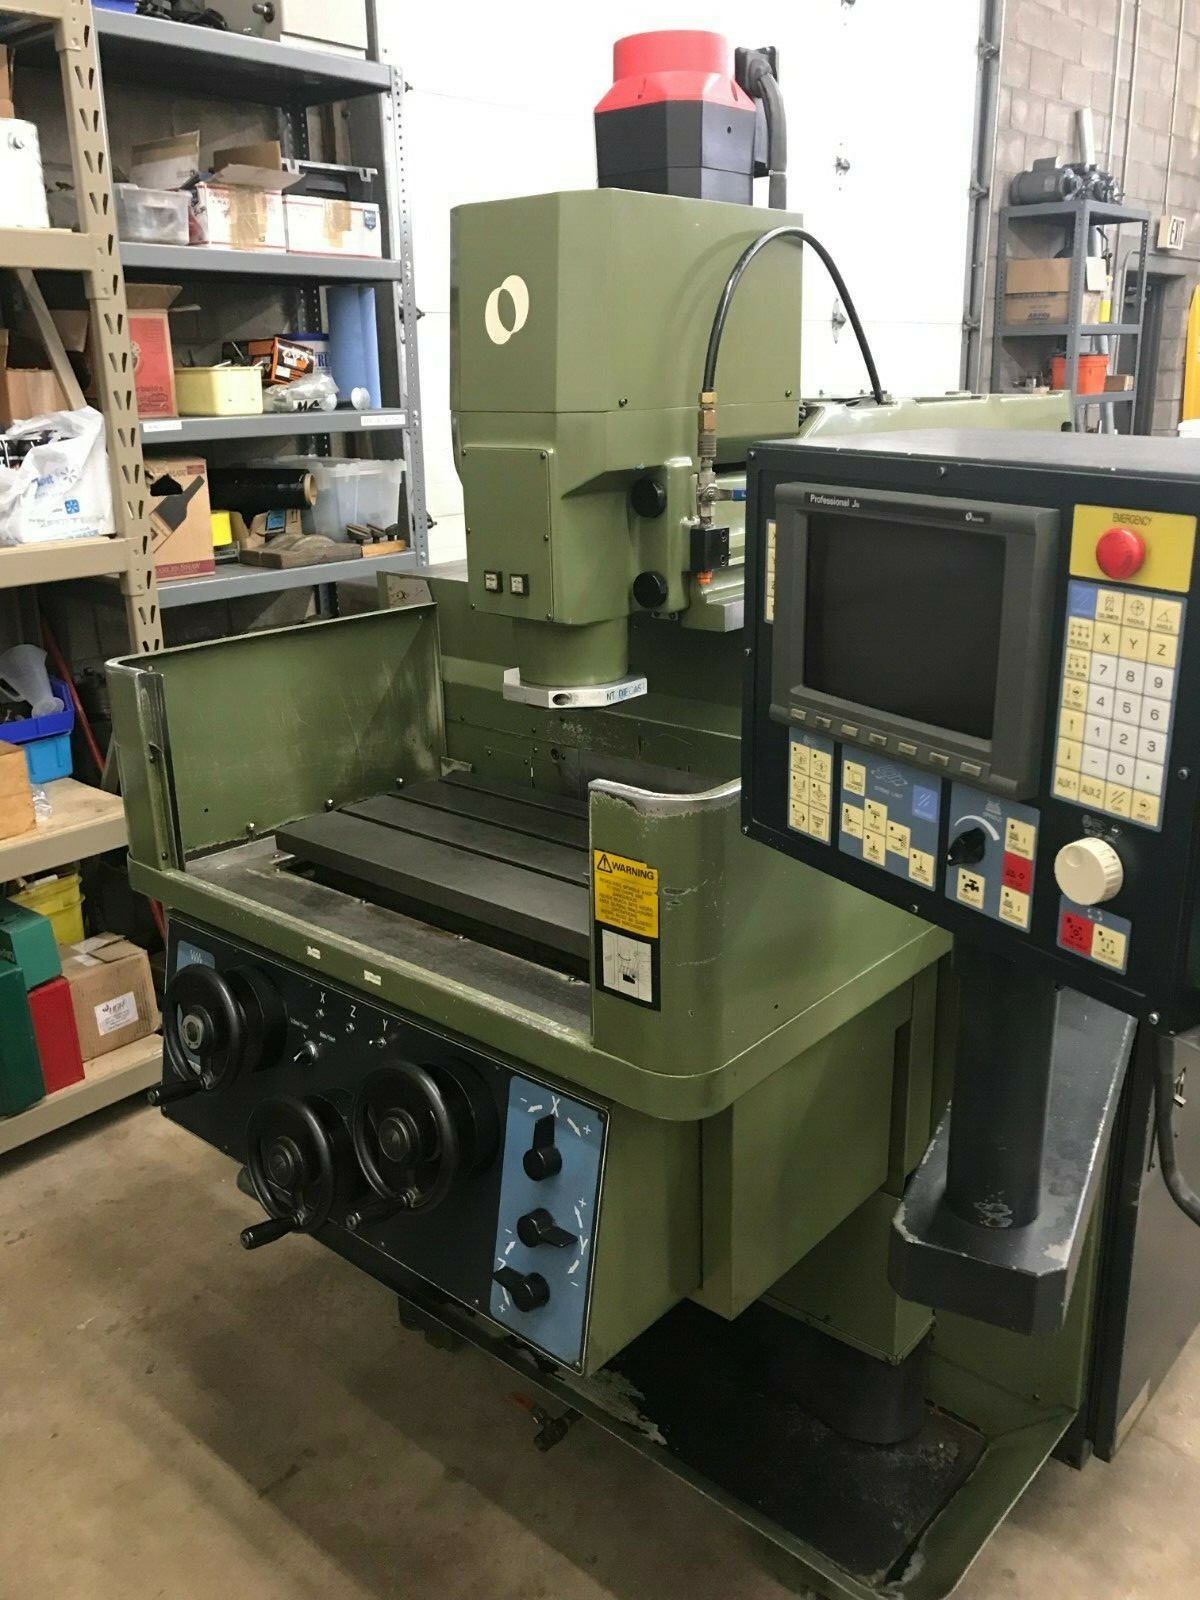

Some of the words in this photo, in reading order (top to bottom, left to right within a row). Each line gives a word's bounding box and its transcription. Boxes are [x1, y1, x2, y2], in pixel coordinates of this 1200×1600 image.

[810, 493, 850, 507] Professional
[1112, 512, 1153, 526] EMERGENCY
[1101, 632, 1111, 645] X
[1129, 638, 1138, 650] Y
[1156, 644, 1167, 657] Z
[1099, 663, 1108, 676] 7
[1125, 670, 1136, 683] 8
[1153, 676, 1164, 689] 9
[1096, 696, 1105, 707] 4
[1122, 701, 1132, 714] 5
[1150, 709, 1160, 721] 6
[1094, 726, 1100, 737] 1
[1119, 733, 1129, 745] 2
[1146, 740, 1157, 753] 3
[1116, 764, 1126, 776] 0
[612, 861, 655, 881] WARNING
[319, 991, 327, 1004] X
[350, 1005, 357, 1019] Z
[382, 1018, 389, 1032] Y
[550, 1095, 561, 1118] X
[579, 1234, 589, 1256] Y
